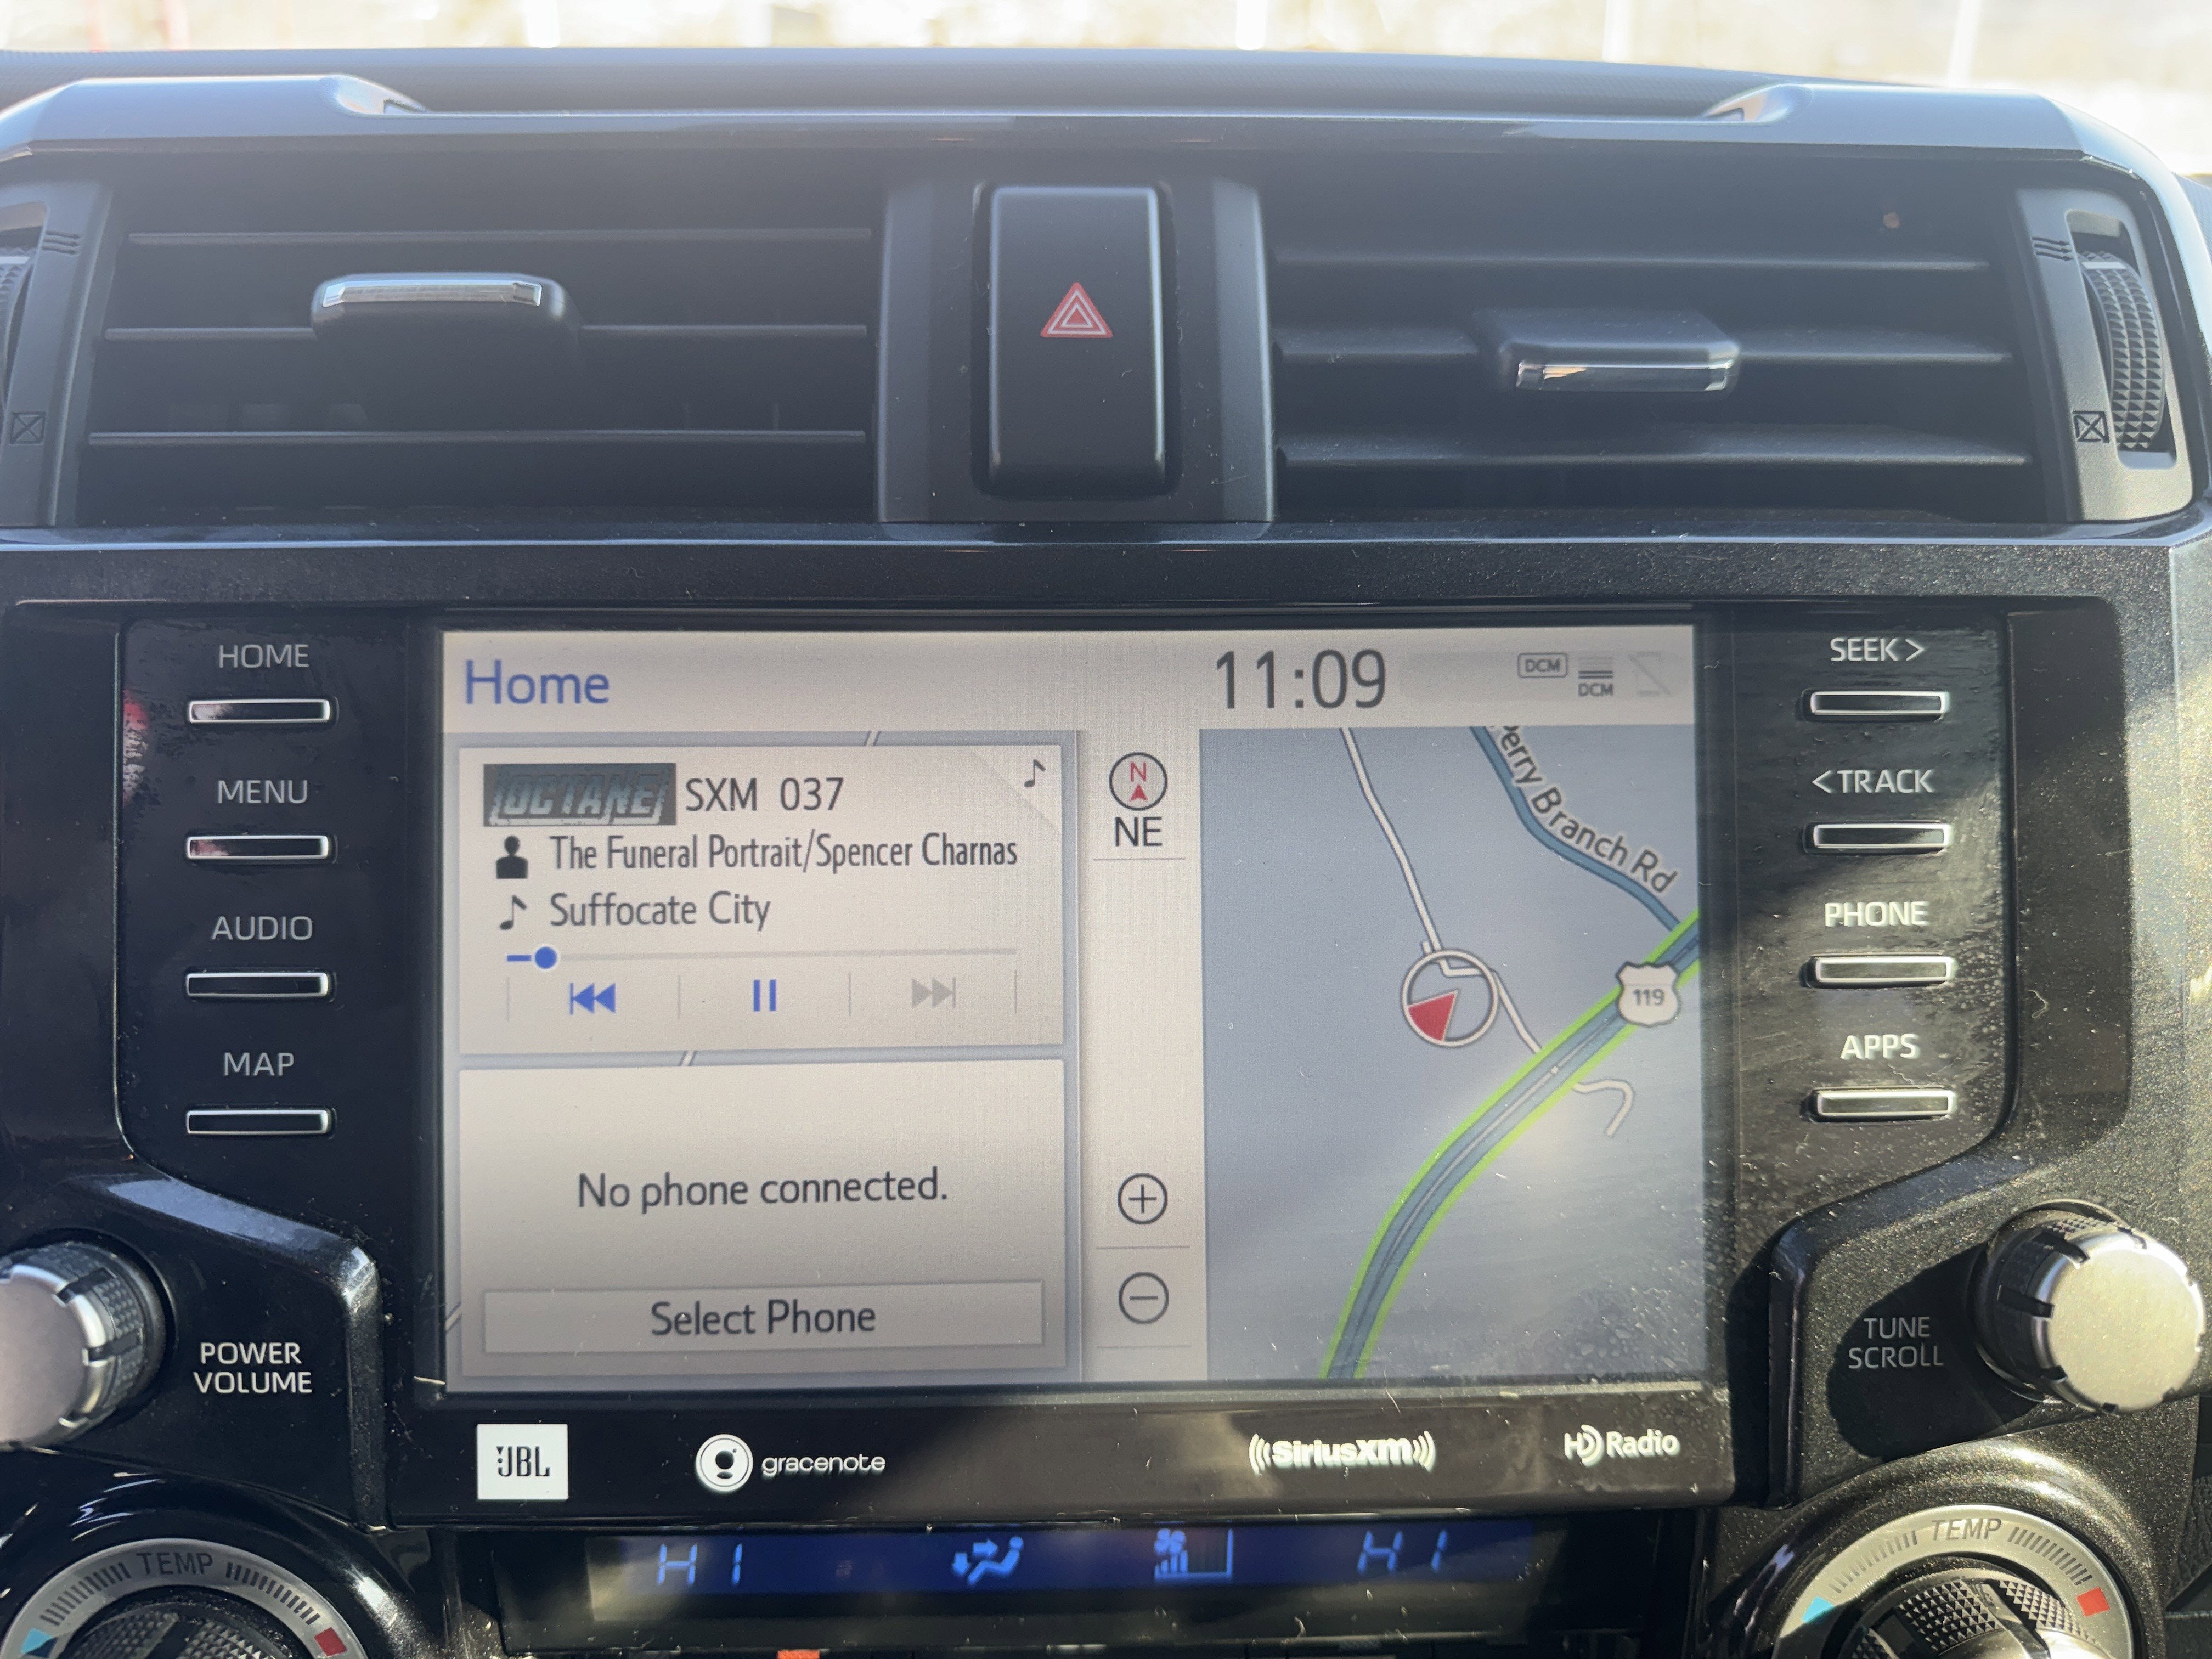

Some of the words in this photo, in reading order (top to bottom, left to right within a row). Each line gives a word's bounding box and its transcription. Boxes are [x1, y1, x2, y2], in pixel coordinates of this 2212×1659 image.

[219, 644, 310, 668] HOME
[1525, 658, 1560, 673] DCM
[465, 659, 610, 704] Home
[1216, 649, 1386, 709] 11:09
[1578, 683, 1613, 696] DCM
[1130, 761, 1148, 782] N
[218, 780, 308, 804] MENU
[685, 777, 758, 812] SXM
[780, 777, 844, 811] 037
[1496, 726, 1543, 783] erry
[1532, 787, 1629, 867] Branch
[1630, 849, 1678, 893] Rd
[1114, 816, 1163, 847] NE
[549, 835, 597, 870] The
[607, 834, 698, 868] Funeral
[922, 831, 1018, 865] Charnas
[550, 892, 697, 927] Suffocate
[708, 891, 771, 932] City
[1825, 901, 1931, 927] PHONE
[211, 916, 313, 940] AUDIO
[1633, 989, 1664, 1006] 119
[1840, 1034, 1920, 1060] APPS
[223, 1052, 295, 1076] MAP
[578, 1172, 630, 1207] No
[641, 1172, 748, 1214] phone
[760, 1166, 948, 1205] connected.
[651, 1300, 757, 1336] Select
[768, 1299, 876, 1334] Phone
[1864, 1316, 1931, 1339] TUNE
[200, 1342, 302, 1364] POWER
[1848, 1345, 1944, 1369] SCROLL
[193, 1371, 313, 1393] VOLUME
[1564, 1424, 1604, 1468] HD
[1606, 1428, 1681, 1458] Radio
[496, 1446, 551, 1477] JBL
[761, 1453, 885, 1478] gracenote
[1931, 1517, 2002, 1541] TEMP
[137, 1552, 213, 1575] TEMP
